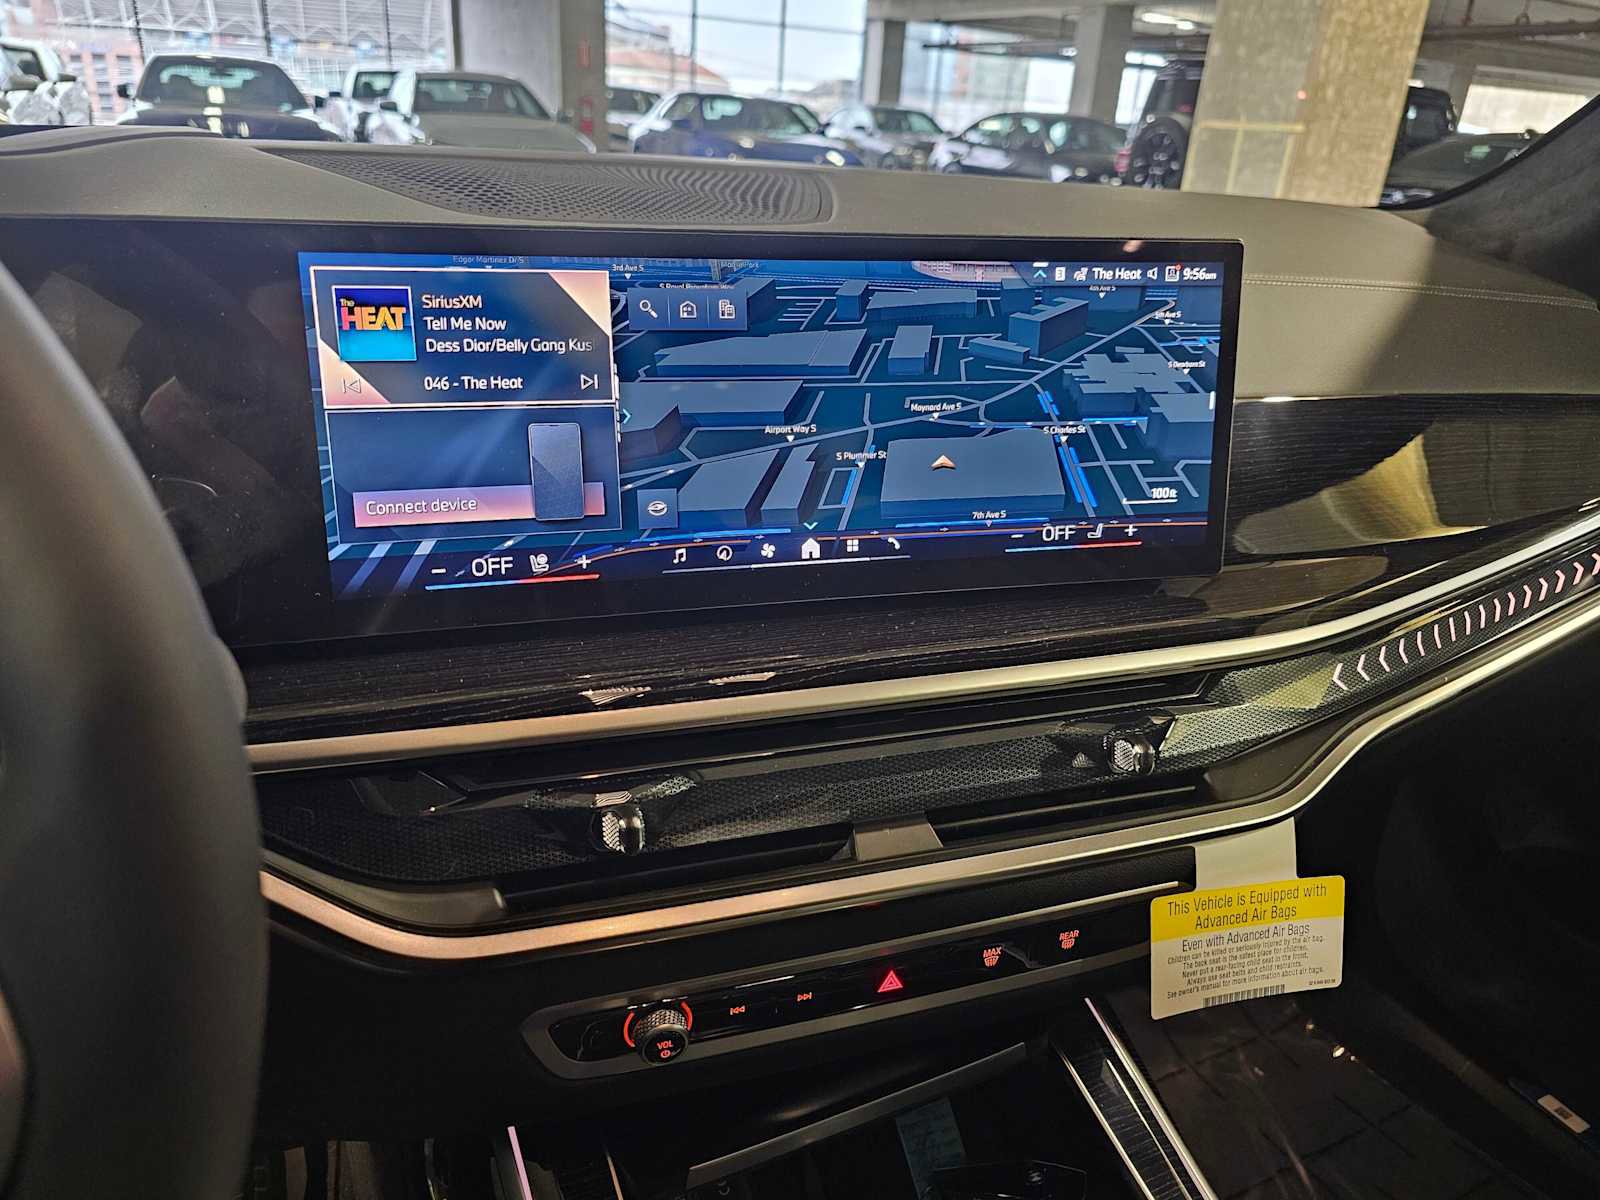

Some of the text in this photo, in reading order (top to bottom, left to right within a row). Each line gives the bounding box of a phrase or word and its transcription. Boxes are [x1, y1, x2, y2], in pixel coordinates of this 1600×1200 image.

[612, 264, 644, 272] 3rd Ave S
[1092, 267, 1142, 280] The Heat
[422, 294, 483, 309] SiriusXM
[341, 306, 407, 331] HEAT
[423, 316, 507, 331] Tell Me Now
[425, 338, 593, 354] Dess Dior/Belly Gang Kus
[1168, 361, 1173, 369] S
[424, 376, 450, 391] 046
[461, 375, 488, 390] The
[490, 375, 524, 389] Heat
[910, 402, 962, 413] Maynard Ave S
[764, 424, 817, 435] Airport Way S
[1043, 424, 1086, 435] S Charles St
[836, 451, 887, 460] S Plummer St
[366, 497, 478, 516] Connect device
[972, 510, 1007, 519] 7th Ave S
[1042, 525, 1077, 542] OFF
[471, 557, 514, 577] OFF
[1167, 882, 1328, 917] This Vehicle is Equipped with
[1194, 904, 1297, 930] Advanced Air Bags
[1059, 929, 1080, 941] REAR
[1182, 923, 1311, 952] Even with Advanced Air Bags
[983, 946, 1002, 958] MAX
[1167, 954, 1191, 965] Children
[1212, 947, 1227, 956] killed
[1236, 942, 1262, 952] seriously
[1262, 940, 1283, 949] injured
[1283, 937, 1290, 946] by
[1182, 970, 1198, 979] Never
[1246, 957, 1261, 967] child
[1194, 959, 1208, 968] back
[1187, 977, 1207, 987] Always
[1247, 965, 1258, 974] and
[1200, 981, 1221, 991] manual
[1232, 977, 1247, 985] more
[1247, 971, 1281, 983] information
[1282, 968, 1298, 977] about
[656, 1039, 674, 1050] VOL
